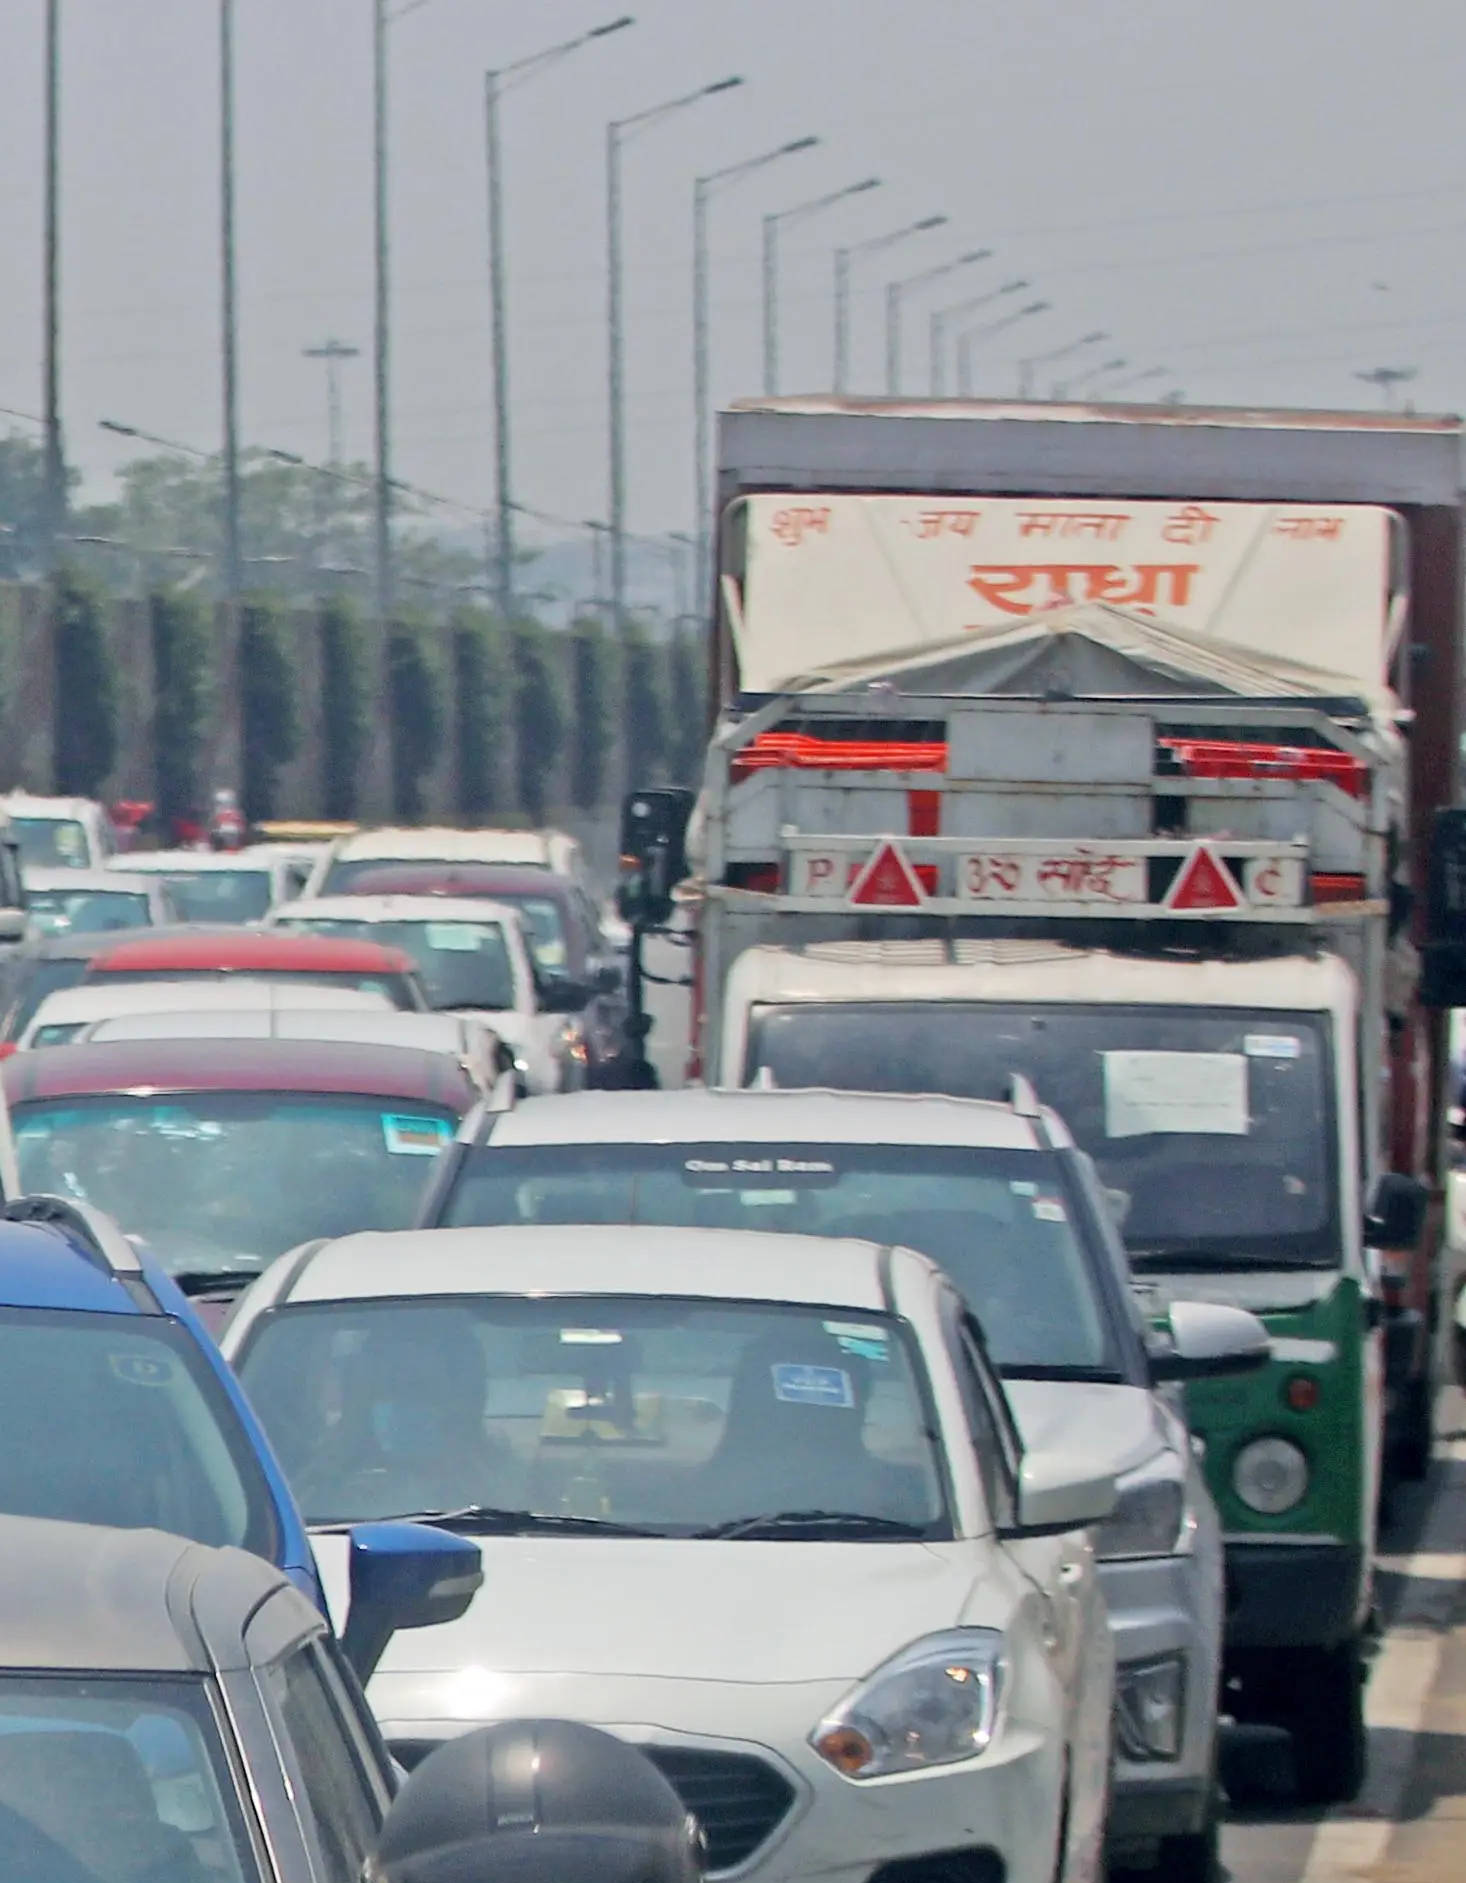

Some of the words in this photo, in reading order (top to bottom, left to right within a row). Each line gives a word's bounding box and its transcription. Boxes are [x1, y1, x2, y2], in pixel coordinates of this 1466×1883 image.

[917, 510, 982, 539] जय
[1015, 511, 1132, 542] माता
[1160, 506, 1222, 545] दी
[684, 1159, 729, 1172] Om
[732, 1159, 773, 1172] Sai
[776, 1158, 834, 1173] Ram
